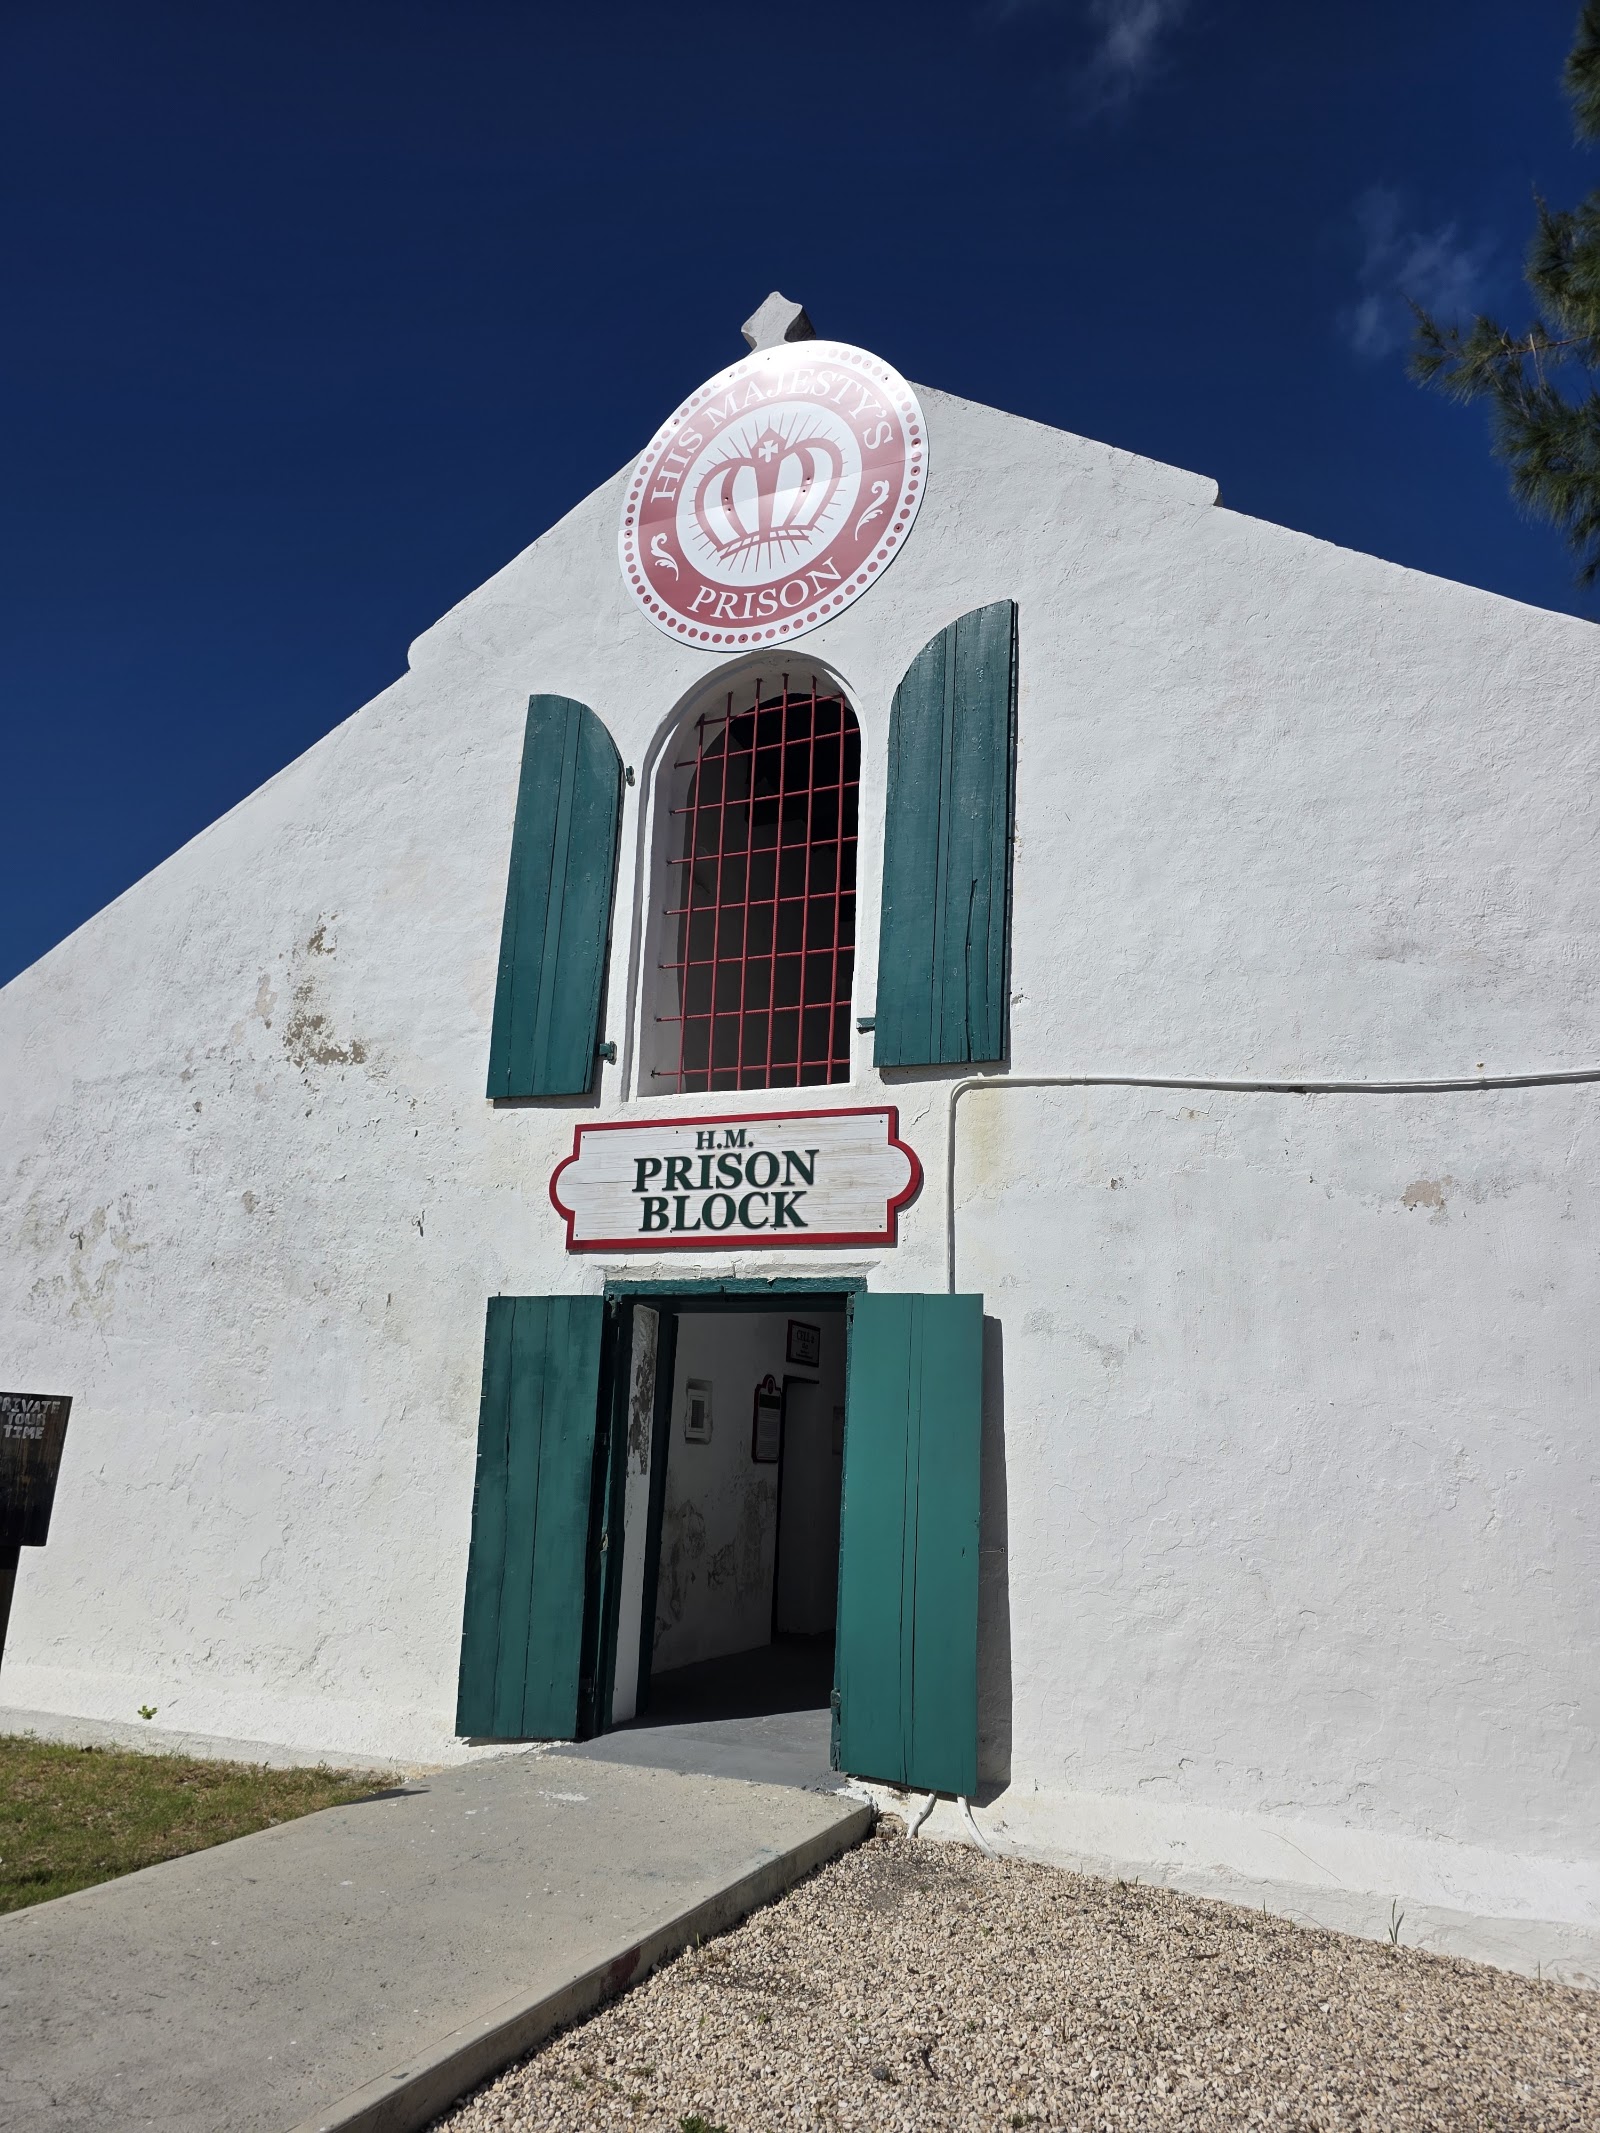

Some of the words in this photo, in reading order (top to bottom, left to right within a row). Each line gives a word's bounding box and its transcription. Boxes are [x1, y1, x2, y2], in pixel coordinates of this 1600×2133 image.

[650, 427, 703, 503] HIS
[686, 557, 843, 620] PRISON
[695, 1128, 754, 1151] H.M.
[632, 1149, 820, 1192] PRISON
[638, 1191, 808, 1232] BLOCK
[3, 1425, 45, 1439] TIME
[6, 1412, 46, 1426] TOUR
